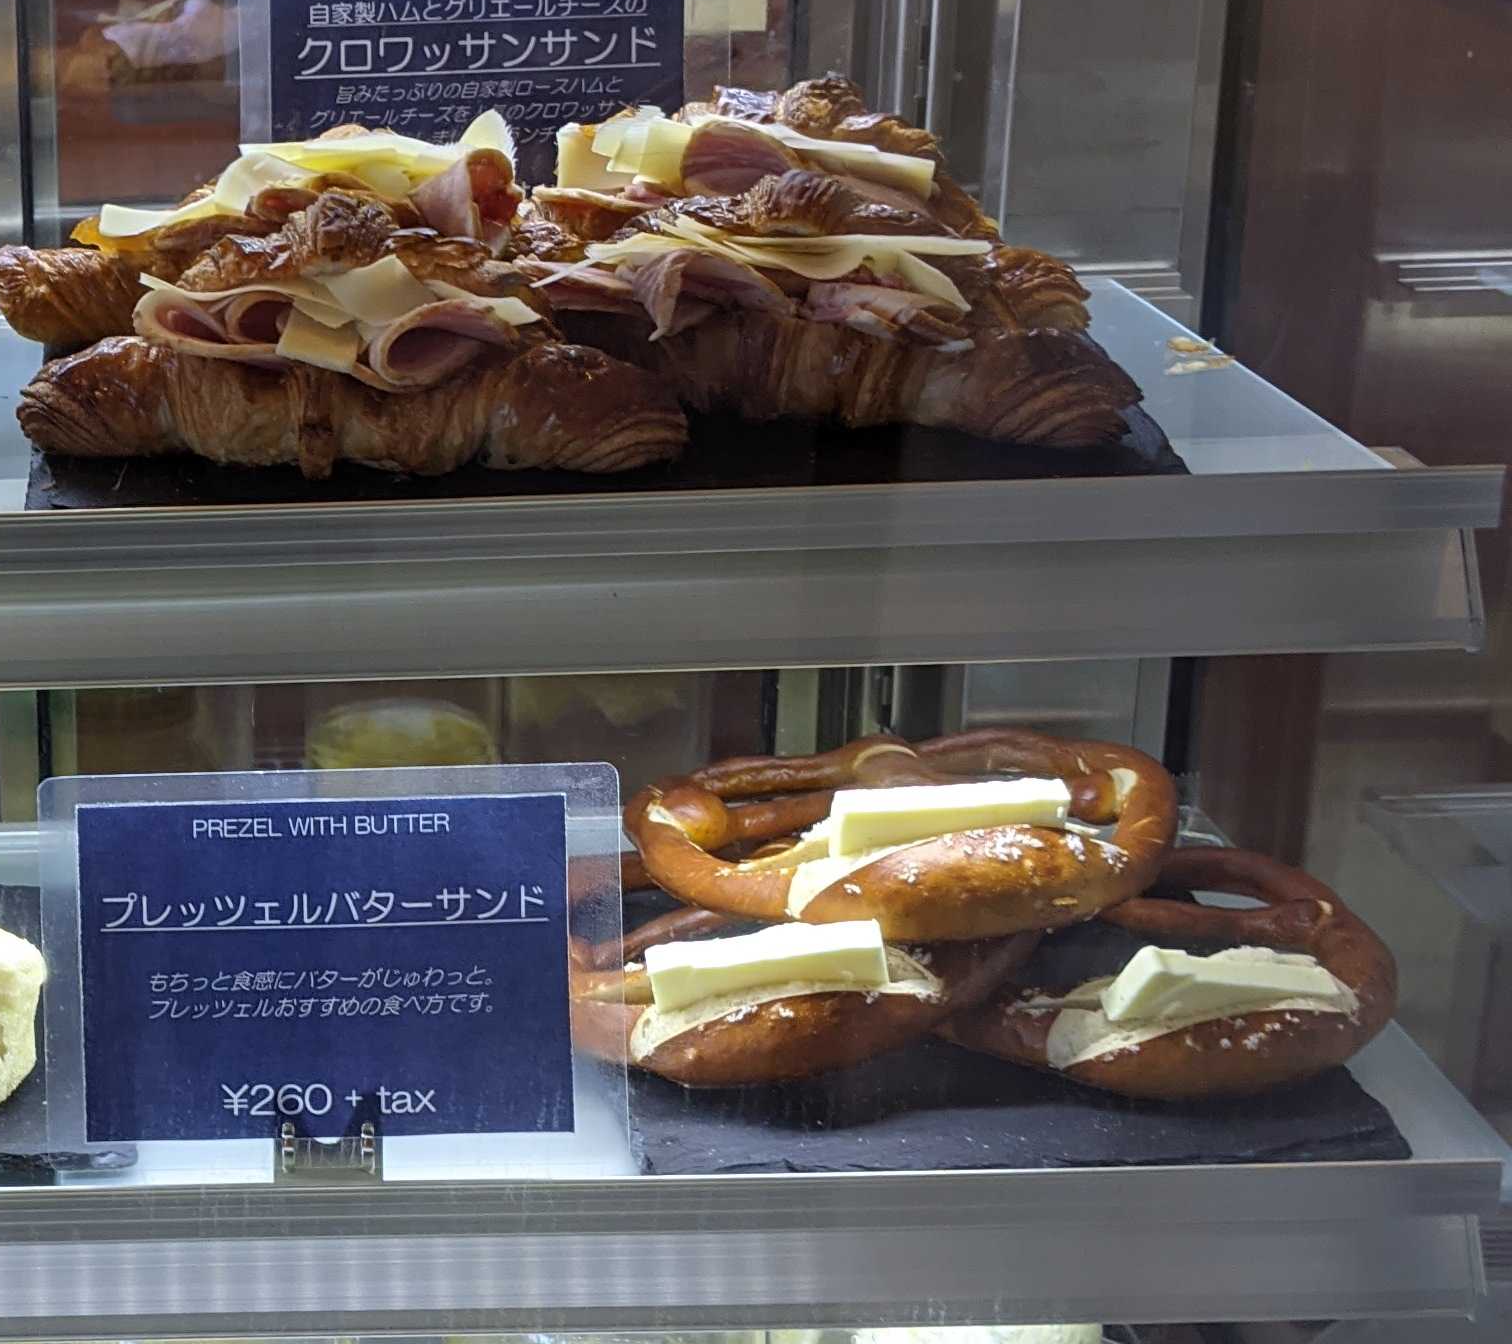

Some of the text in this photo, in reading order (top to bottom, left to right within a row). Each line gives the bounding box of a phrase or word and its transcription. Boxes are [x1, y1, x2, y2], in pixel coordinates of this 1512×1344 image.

[297, 26, 657, 75] クロワッサンサンド
[193, 814, 449, 839] PREZEL WITH BUTTER
[101, 885, 545, 928] プレッツェルバターサンド
[223, 1084, 436, 1117] ¥260 + tax
